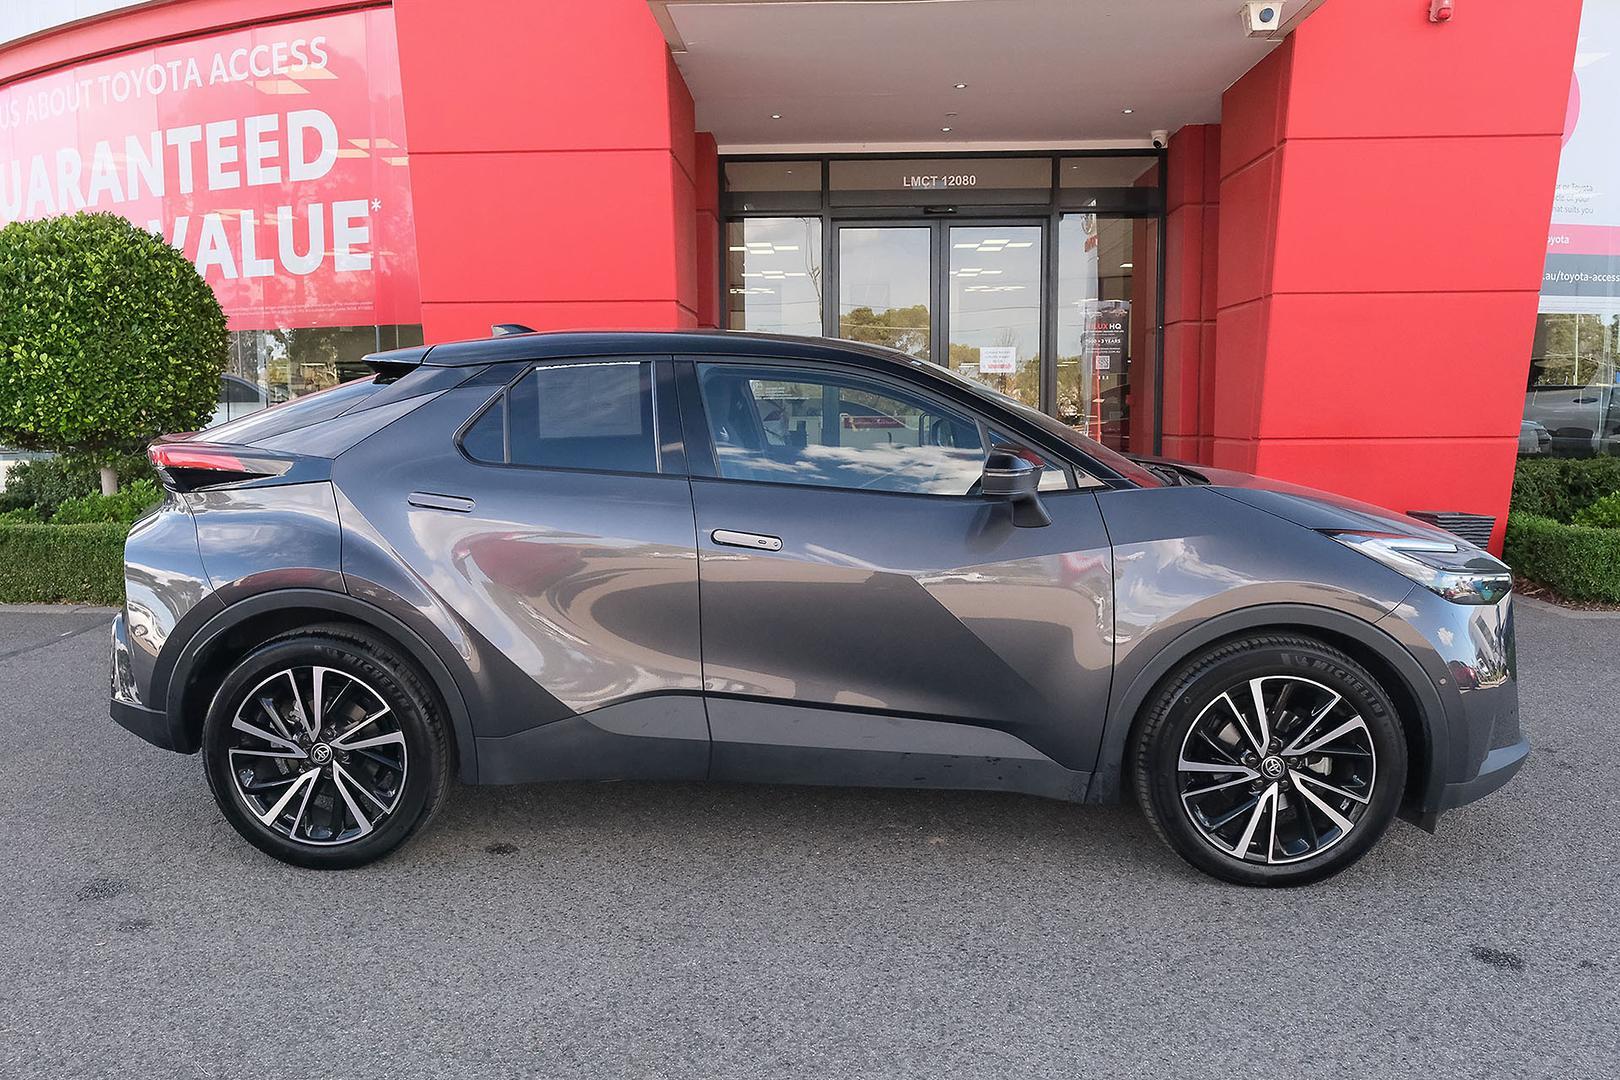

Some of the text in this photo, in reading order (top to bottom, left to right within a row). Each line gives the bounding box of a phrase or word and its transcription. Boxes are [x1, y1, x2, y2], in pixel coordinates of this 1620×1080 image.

[0, 36, 328, 129] US ABOUT TOYOTA ACCESS
[903, 175, 976, 187] LMCT 12080
[1565, 206, 1580, 214] suits
[1581, 207, 1594, 216] you
[1312, 659, 1384, 714] MICHELIN
